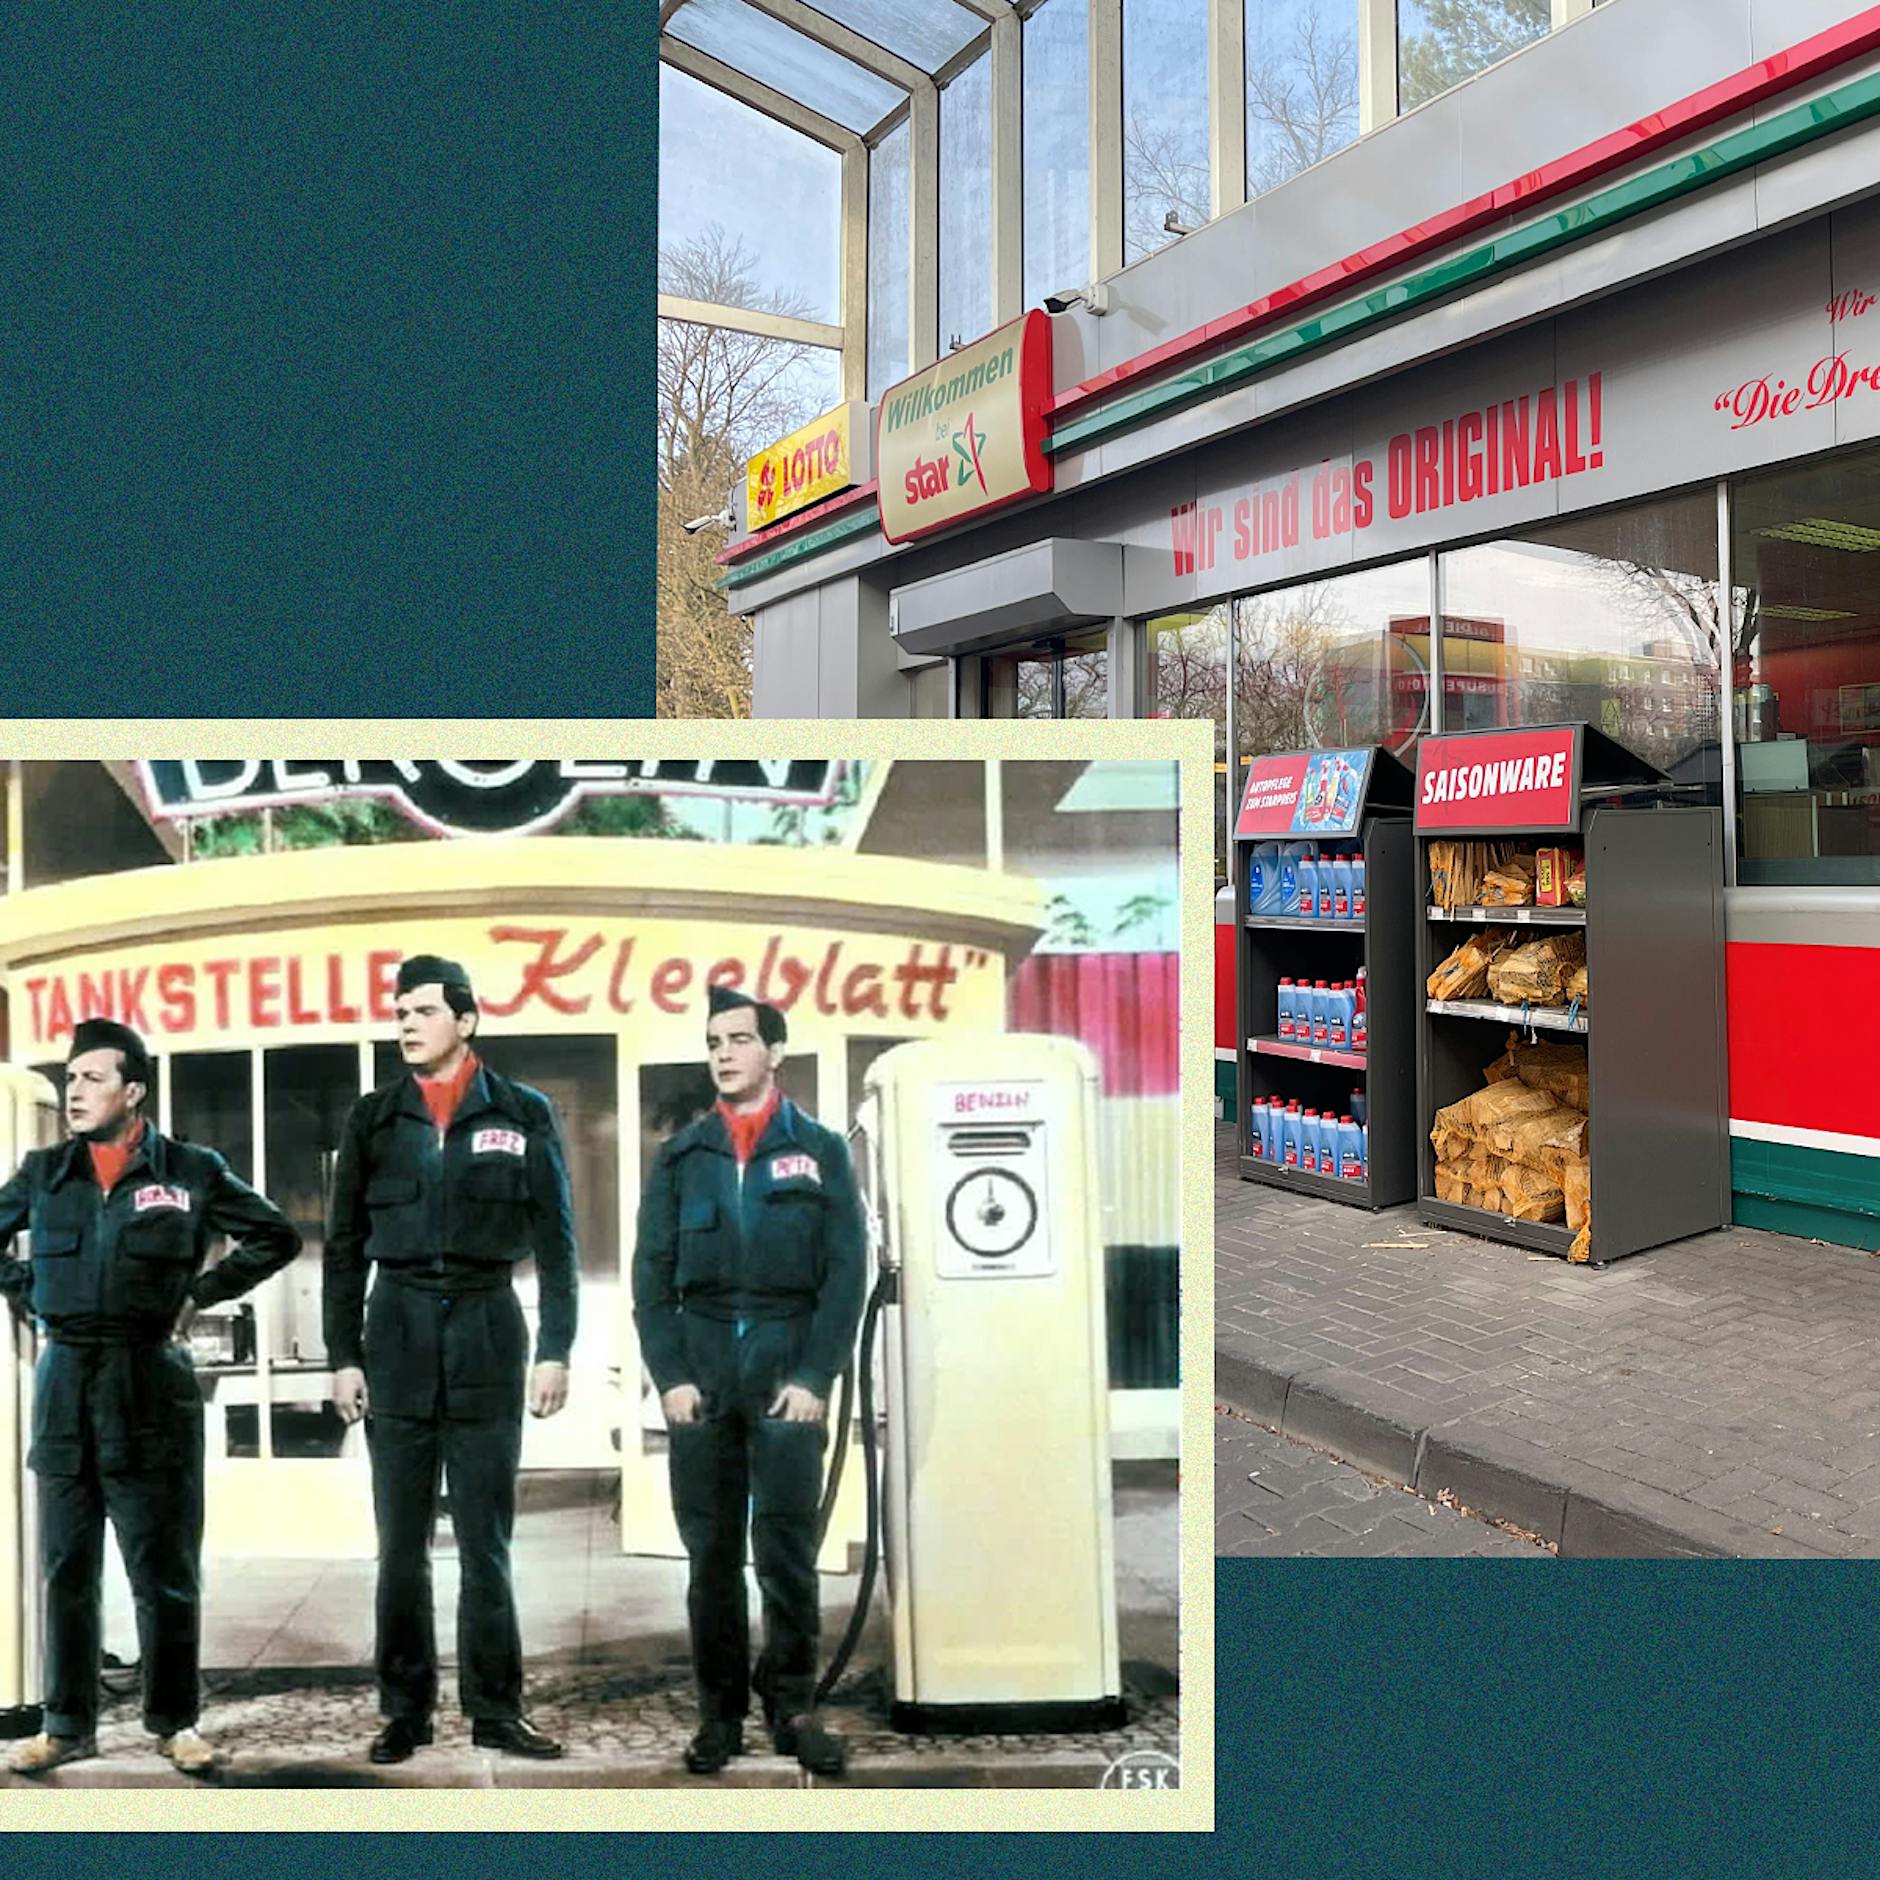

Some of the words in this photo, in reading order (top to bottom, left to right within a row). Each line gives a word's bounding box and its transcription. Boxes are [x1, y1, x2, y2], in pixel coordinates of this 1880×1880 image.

[1826, 288, 1877, 324] Wir
[888, 347, 1013, 433] Willkommen
[936, 418, 951, 441] bei
[783, 429, 839, 498] LOTTO
[905, 455, 950, 505] star
[1171, 500, 1223, 577] Wir
[1234, 467, 1299, 561] sind
[1312, 457, 1373, 541] das
[1388, 371, 1604, 520] ORIGINAL!
[1422, 752, 1567, 805] SAISONWARE
[26, 949, 403, 1043] TANKSTELLE
[954, 1090, 1030, 1113] BENZIN
